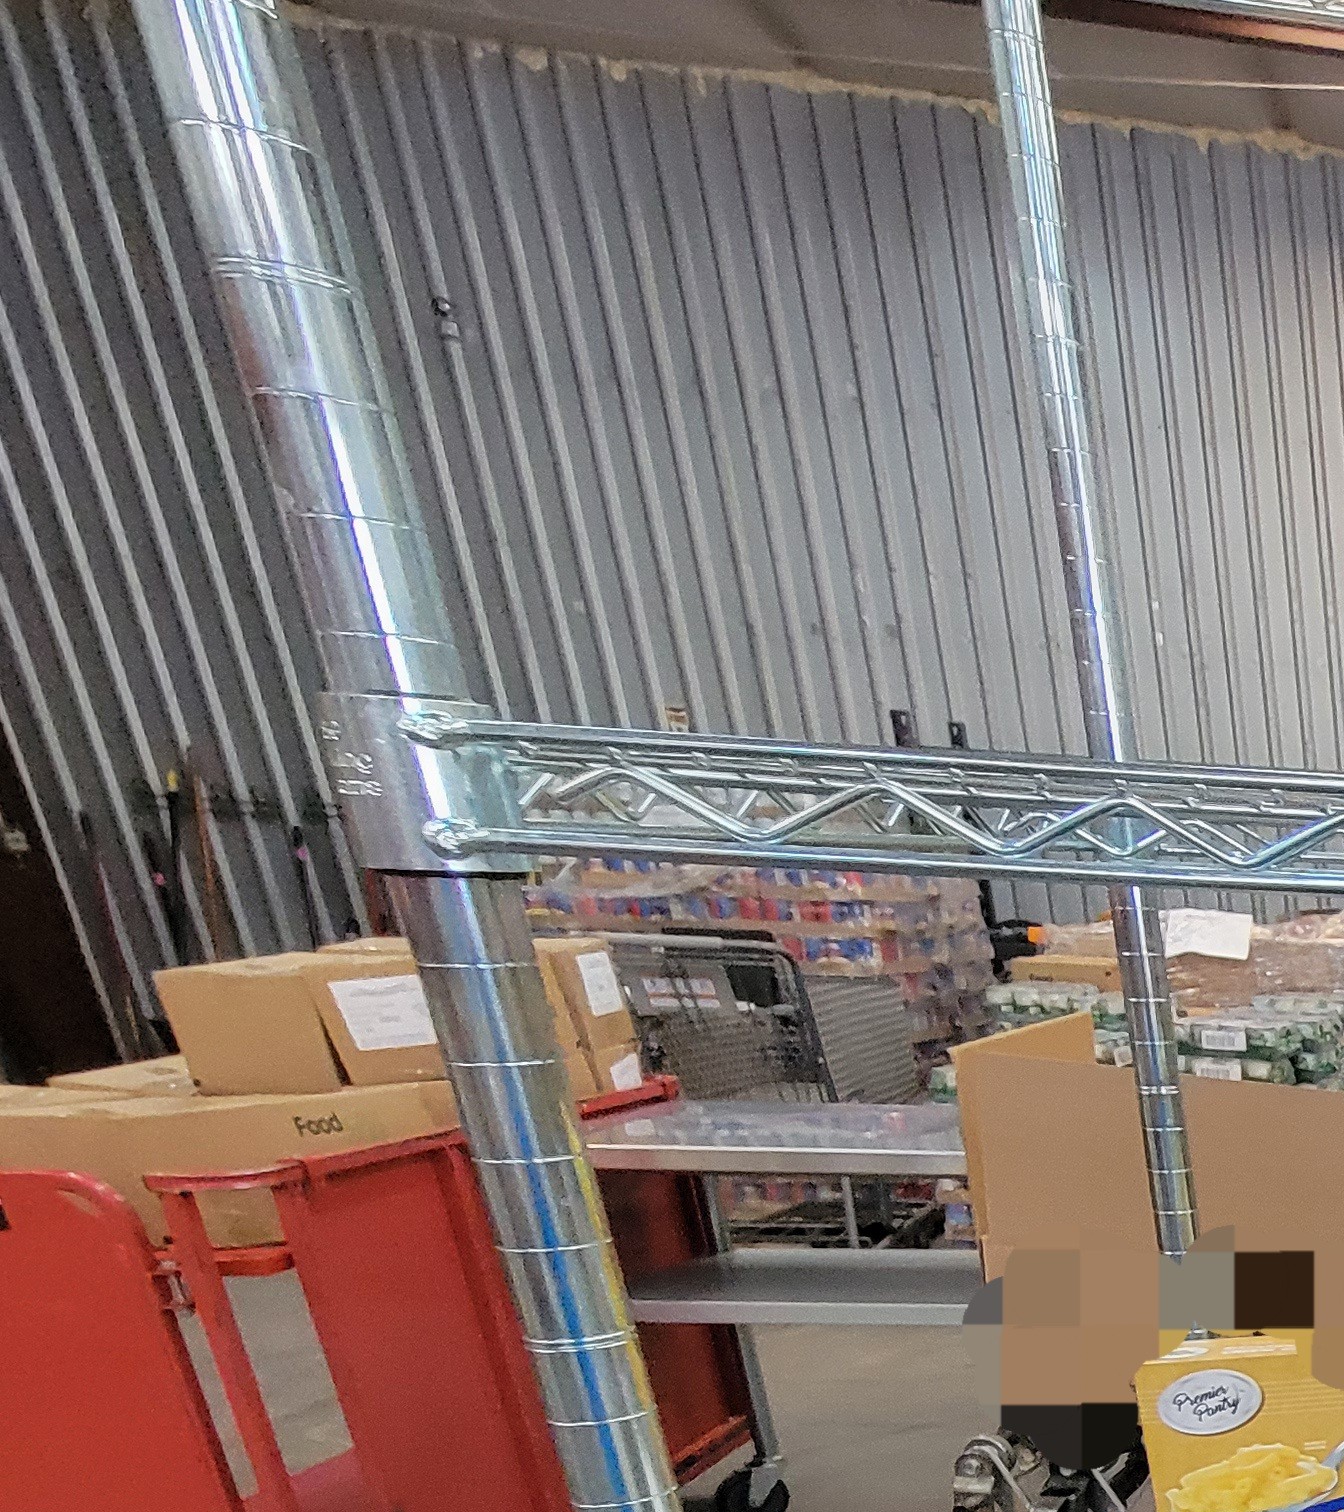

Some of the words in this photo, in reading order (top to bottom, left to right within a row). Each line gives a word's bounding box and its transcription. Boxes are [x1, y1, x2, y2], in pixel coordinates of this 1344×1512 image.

[292, 1113, 343, 1137] Food
[1172, 1384, 1231, 1411] Premier
[1192, 1397, 1240, 1423] Pantry
